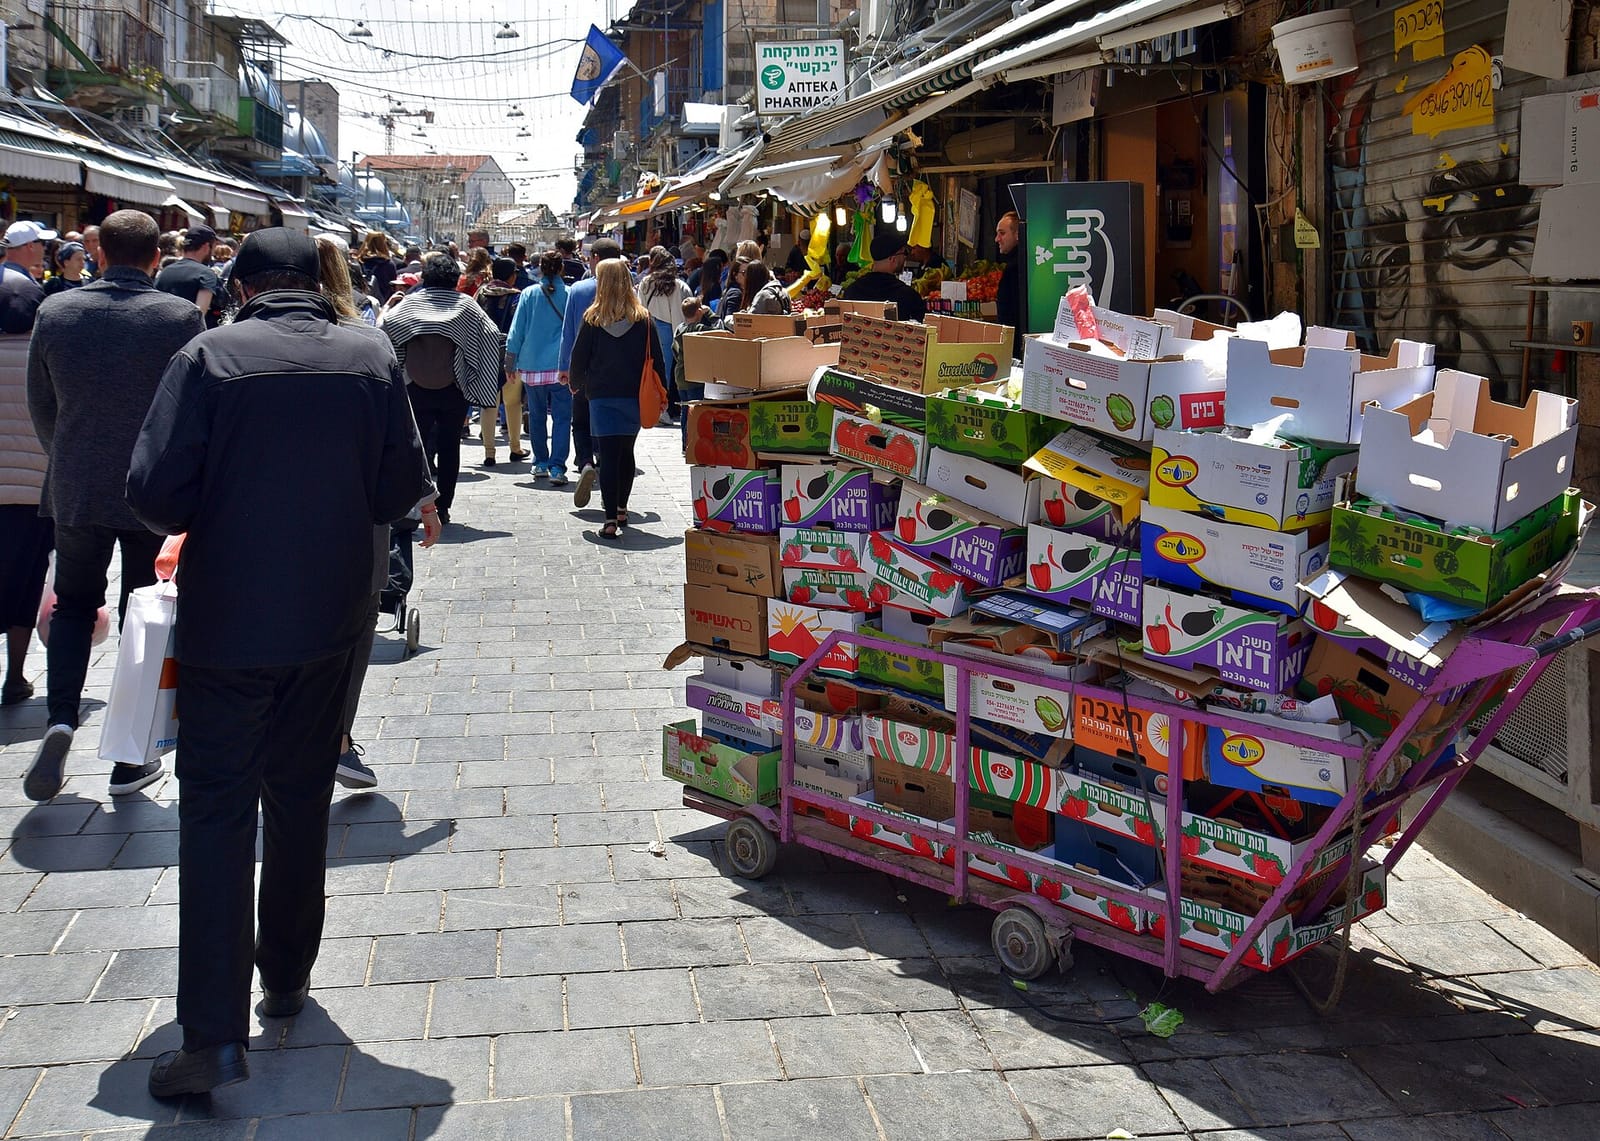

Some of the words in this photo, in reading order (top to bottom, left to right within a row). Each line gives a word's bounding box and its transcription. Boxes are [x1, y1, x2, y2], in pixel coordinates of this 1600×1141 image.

[762, 46, 810, 61] מרקחת
[815, 45, 838, 57] בית
[786, 60, 838, 76] "בקשי"
[788, 81, 838, 93] АПТЕКА
[764, 95, 839, 108] PHARMACY
[1571, 159, 1578, 172] 16
[937, 362, 964, 377] Sweet
[969, 362, 986, 377] Bite
[964, 406, 996, 420] נבחרי
[1191, 402, 1218, 418] בנים
[954, 414, 983, 427] ערבה
[1162, 467, 1174, 476] יהב
[1182, 470, 1192, 479] עין
[745, 490, 763, 500] משק
[847, 488, 867, 497] משק
[732, 499, 763, 520] דואן
[831, 497, 867, 520] דואן
[798, 530, 818, 543] מובחר
[817, 532, 832, 543] שדה
[832, 533, 845, 544] תות
[972, 535, 995, 551] משק
[1377, 534, 1422, 554] ערבה
[1394, 525, 1443, 548] נבחרי
[1162, 540, 1177, 550] יהב
[1187, 546, 1199, 556] עין
[1260, 546, 1271, 555] של
[950, 537, 994, 571] דואן
[843, 574, 854, 586] תות
[1114, 571, 1139, 587] משק
[1091, 576, 1140, 609] דואן
[1241, 635, 1271, 651] משק
[1216, 640, 1271, 675] דואן
[1081, 697, 1143, 732] חצבה
[1082, 716, 1112, 733] הערבה
[1227, 744, 1239, 753] יהב
[1248, 749, 1259, 758] עין
[1085, 784, 1109, 805] מובחר
[1110, 791, 1129, 810] שדה
[1196, 819, 1225, 841] מובחר
[1226, 828, 1246, 846] שדה
[1247, 835, 1265, 852] תות
[1180, 902, 1203, 920] מובח
[1204, 909, 1225, 925] שדה
[1226, 914, 1242, 931] תות
